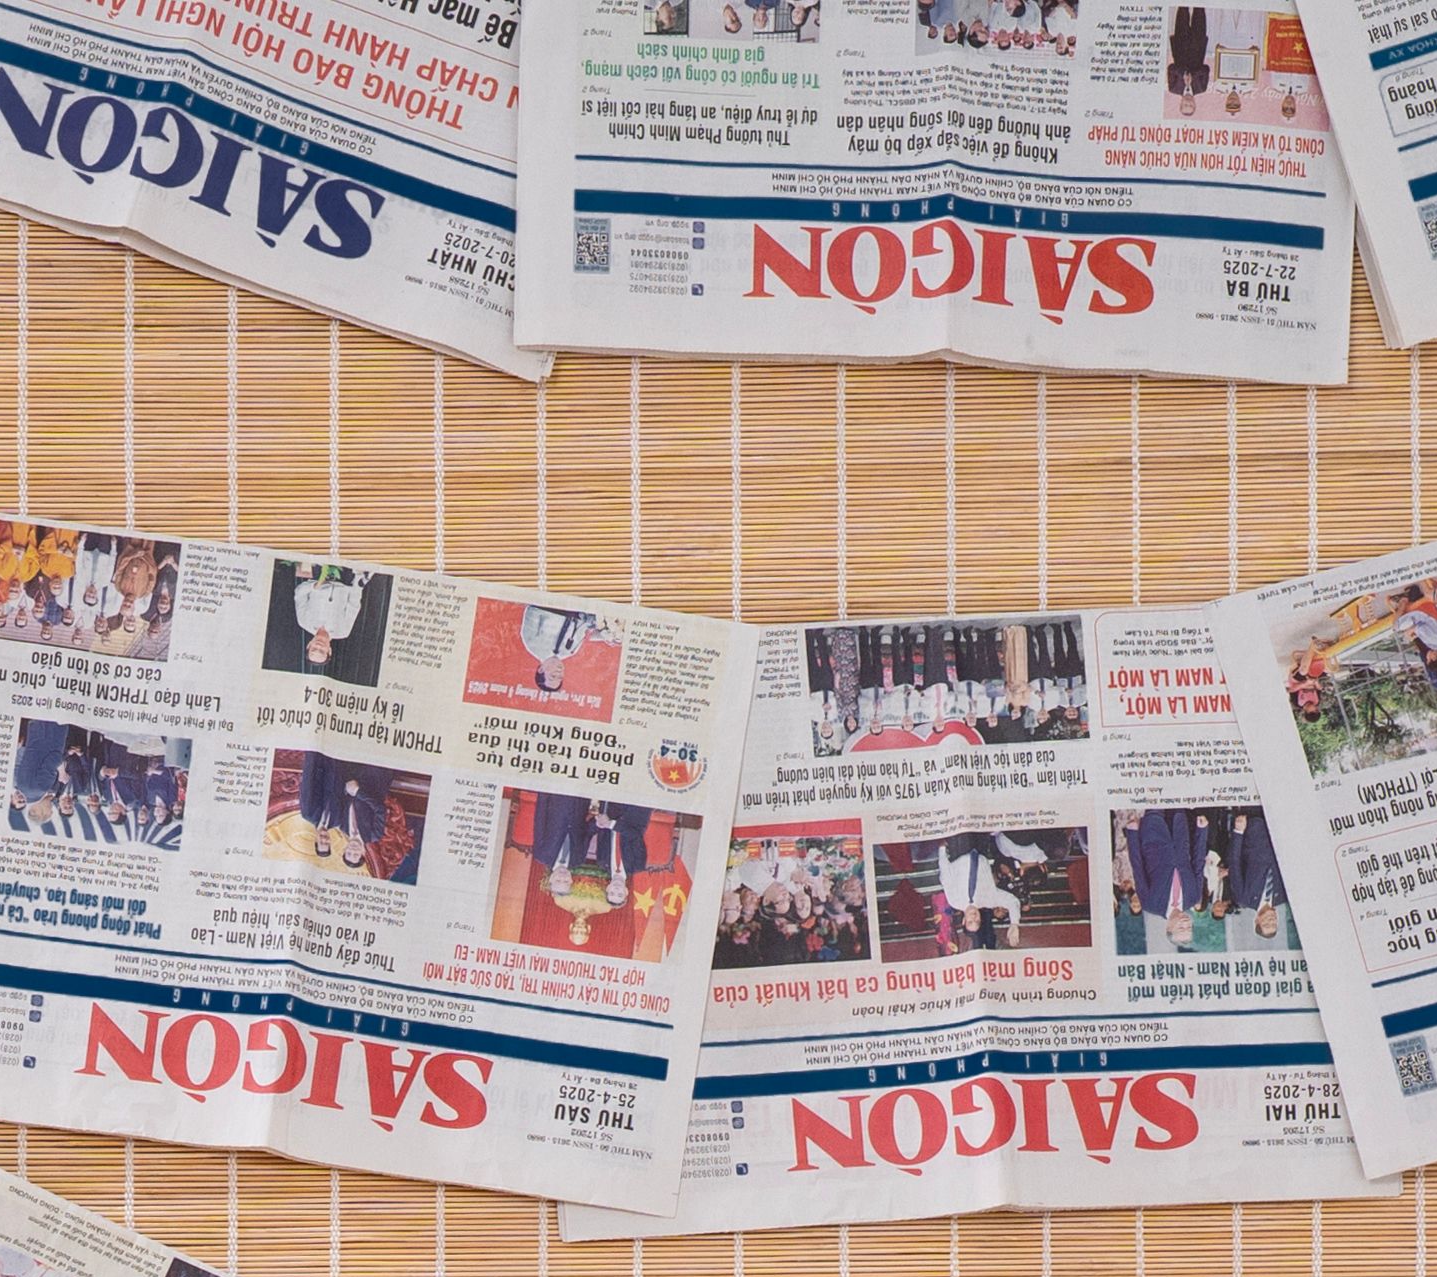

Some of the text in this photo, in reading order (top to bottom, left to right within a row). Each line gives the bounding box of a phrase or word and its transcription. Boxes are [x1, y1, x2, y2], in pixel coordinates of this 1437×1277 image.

[323, 19, 498, 101] CHẤP HÀNH
[232, 21, 462, 129] THÔNG BÁO HỘI
[581, 59, 820, 88] Tri ân người có công với cách mạng,
[427, 247, 477, 274] NHẬT
[1223, 260, 1295, 280] 22-7-2025
[1227, 280, 1290, 302] THỨ BA
[468, 732, 634, 767] phong trào thi đua
[476, 751, 619, 784] Bến Tre tiếp tục
[1387, 935, 1420, 953] học
[713, 957, 1073, 1008] Sống mãi bản hùng ca bất khuất của
[559, 1085, 636, 1108] 25-4-2025
[1264, 1083, 1341, 1099] 28-4-2025
[554, 1104, 633, 1130] THỨ SÁU
[1266, 1102, 1340, 1123] THỨ HAI
